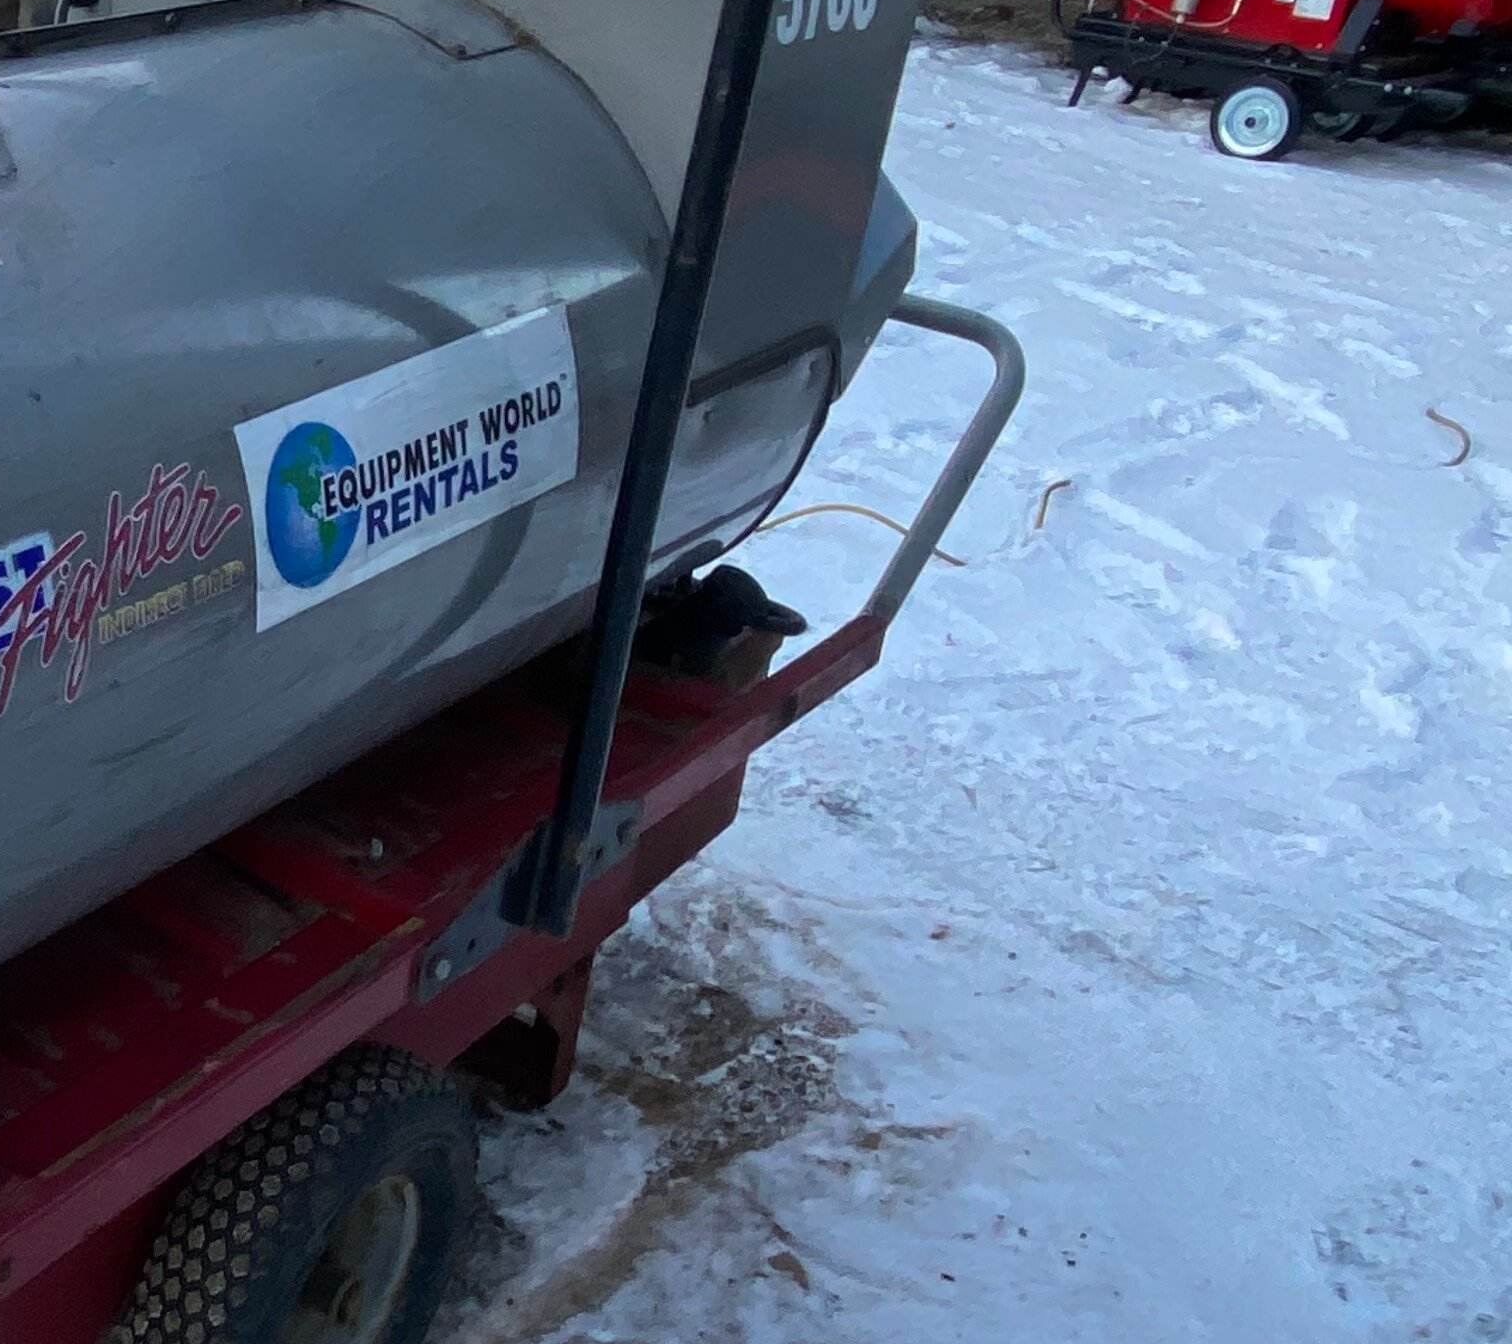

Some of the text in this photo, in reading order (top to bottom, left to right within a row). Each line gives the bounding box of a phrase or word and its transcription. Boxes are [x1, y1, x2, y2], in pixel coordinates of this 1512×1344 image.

[322, 380, 563, 517] EQUIPMENT WORLD
[366, 439, 519, 546] RENTALS
